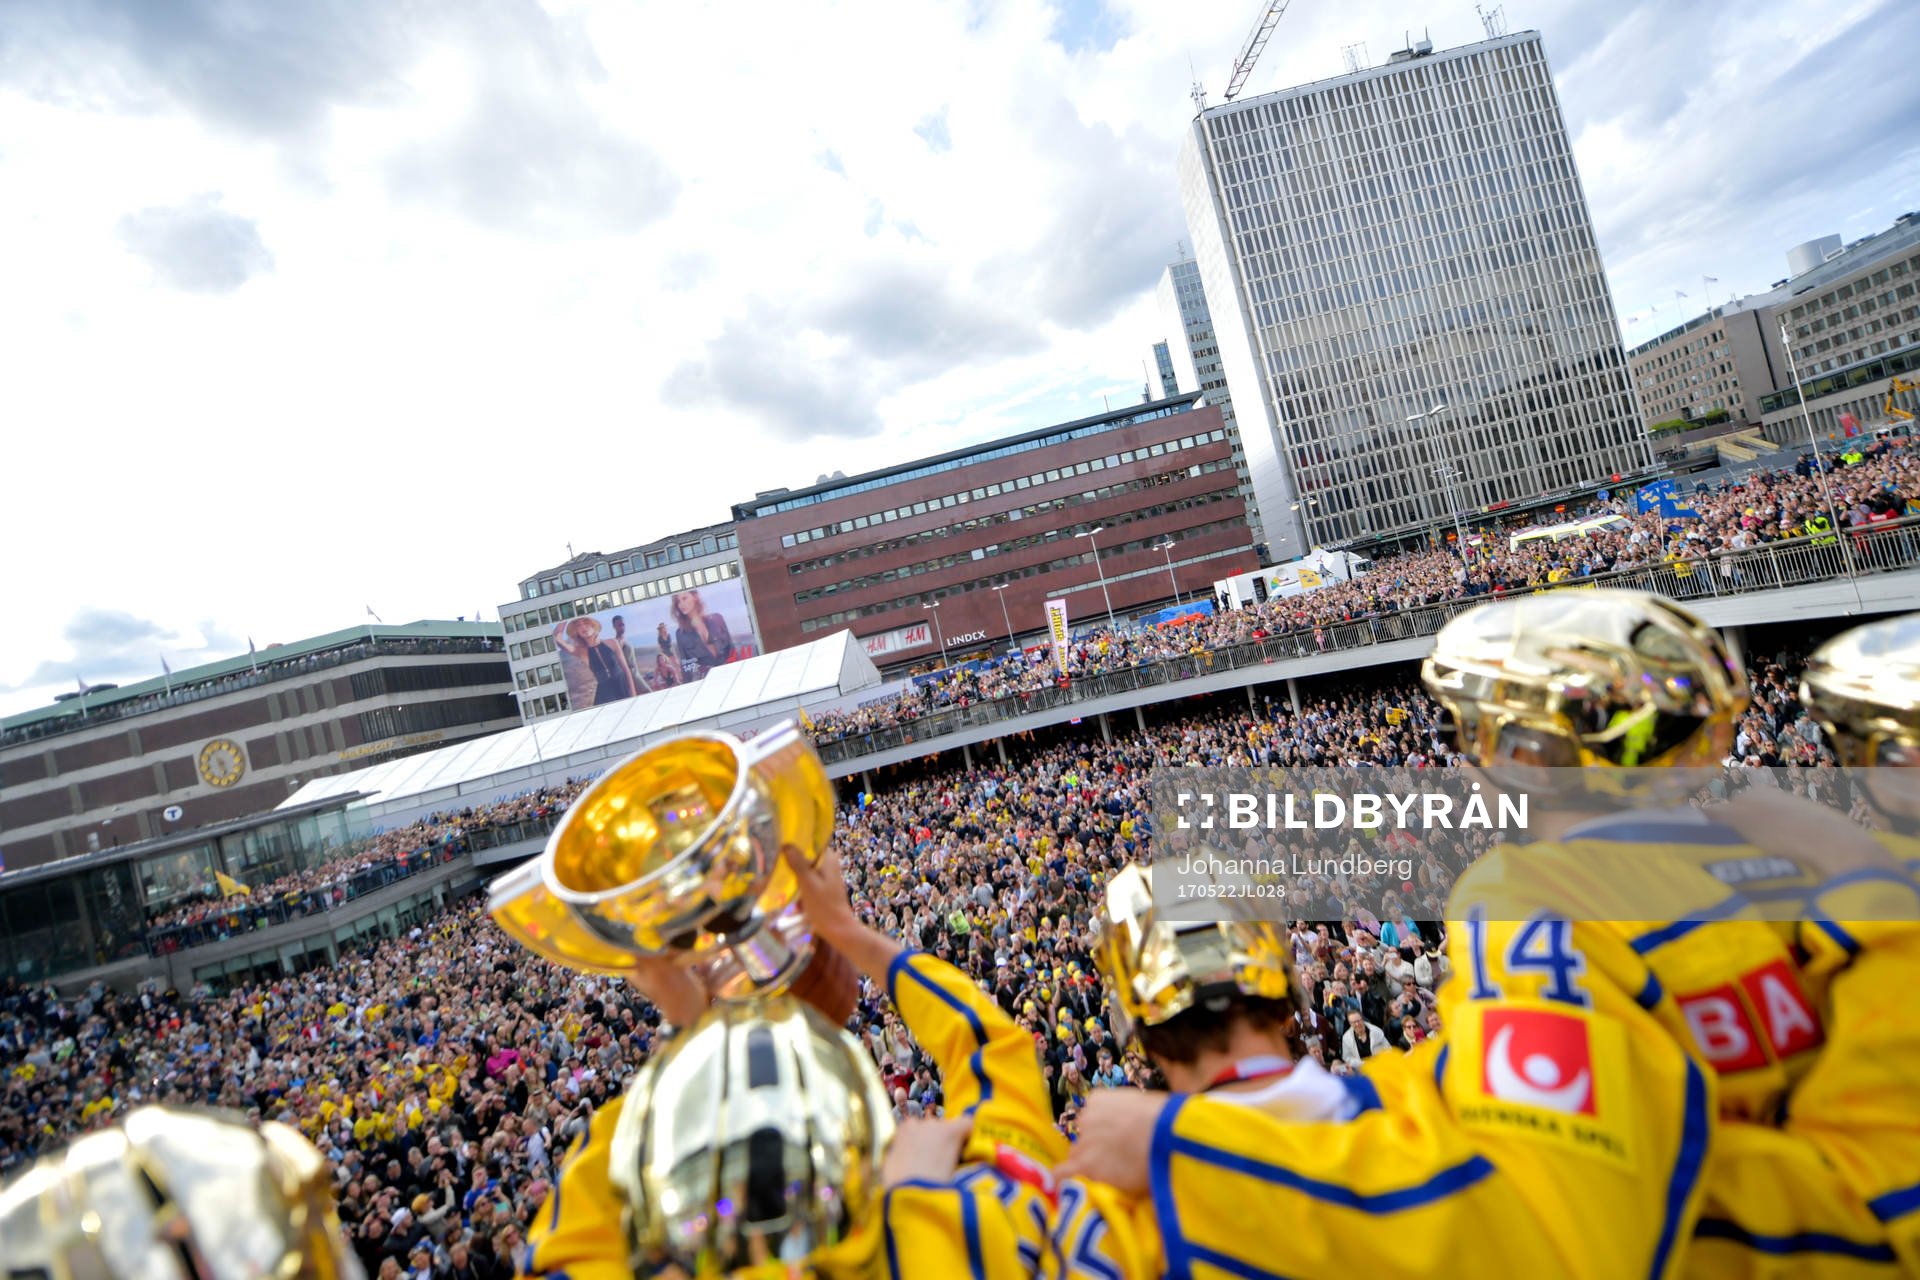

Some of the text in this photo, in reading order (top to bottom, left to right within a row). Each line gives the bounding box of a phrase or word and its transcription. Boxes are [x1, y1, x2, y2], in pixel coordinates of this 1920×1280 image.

[1322, 540, 1353, 551] MANGO
[947, 630, 987, 646] LINDEX
[1466, 905, 1594, 1011] 14
